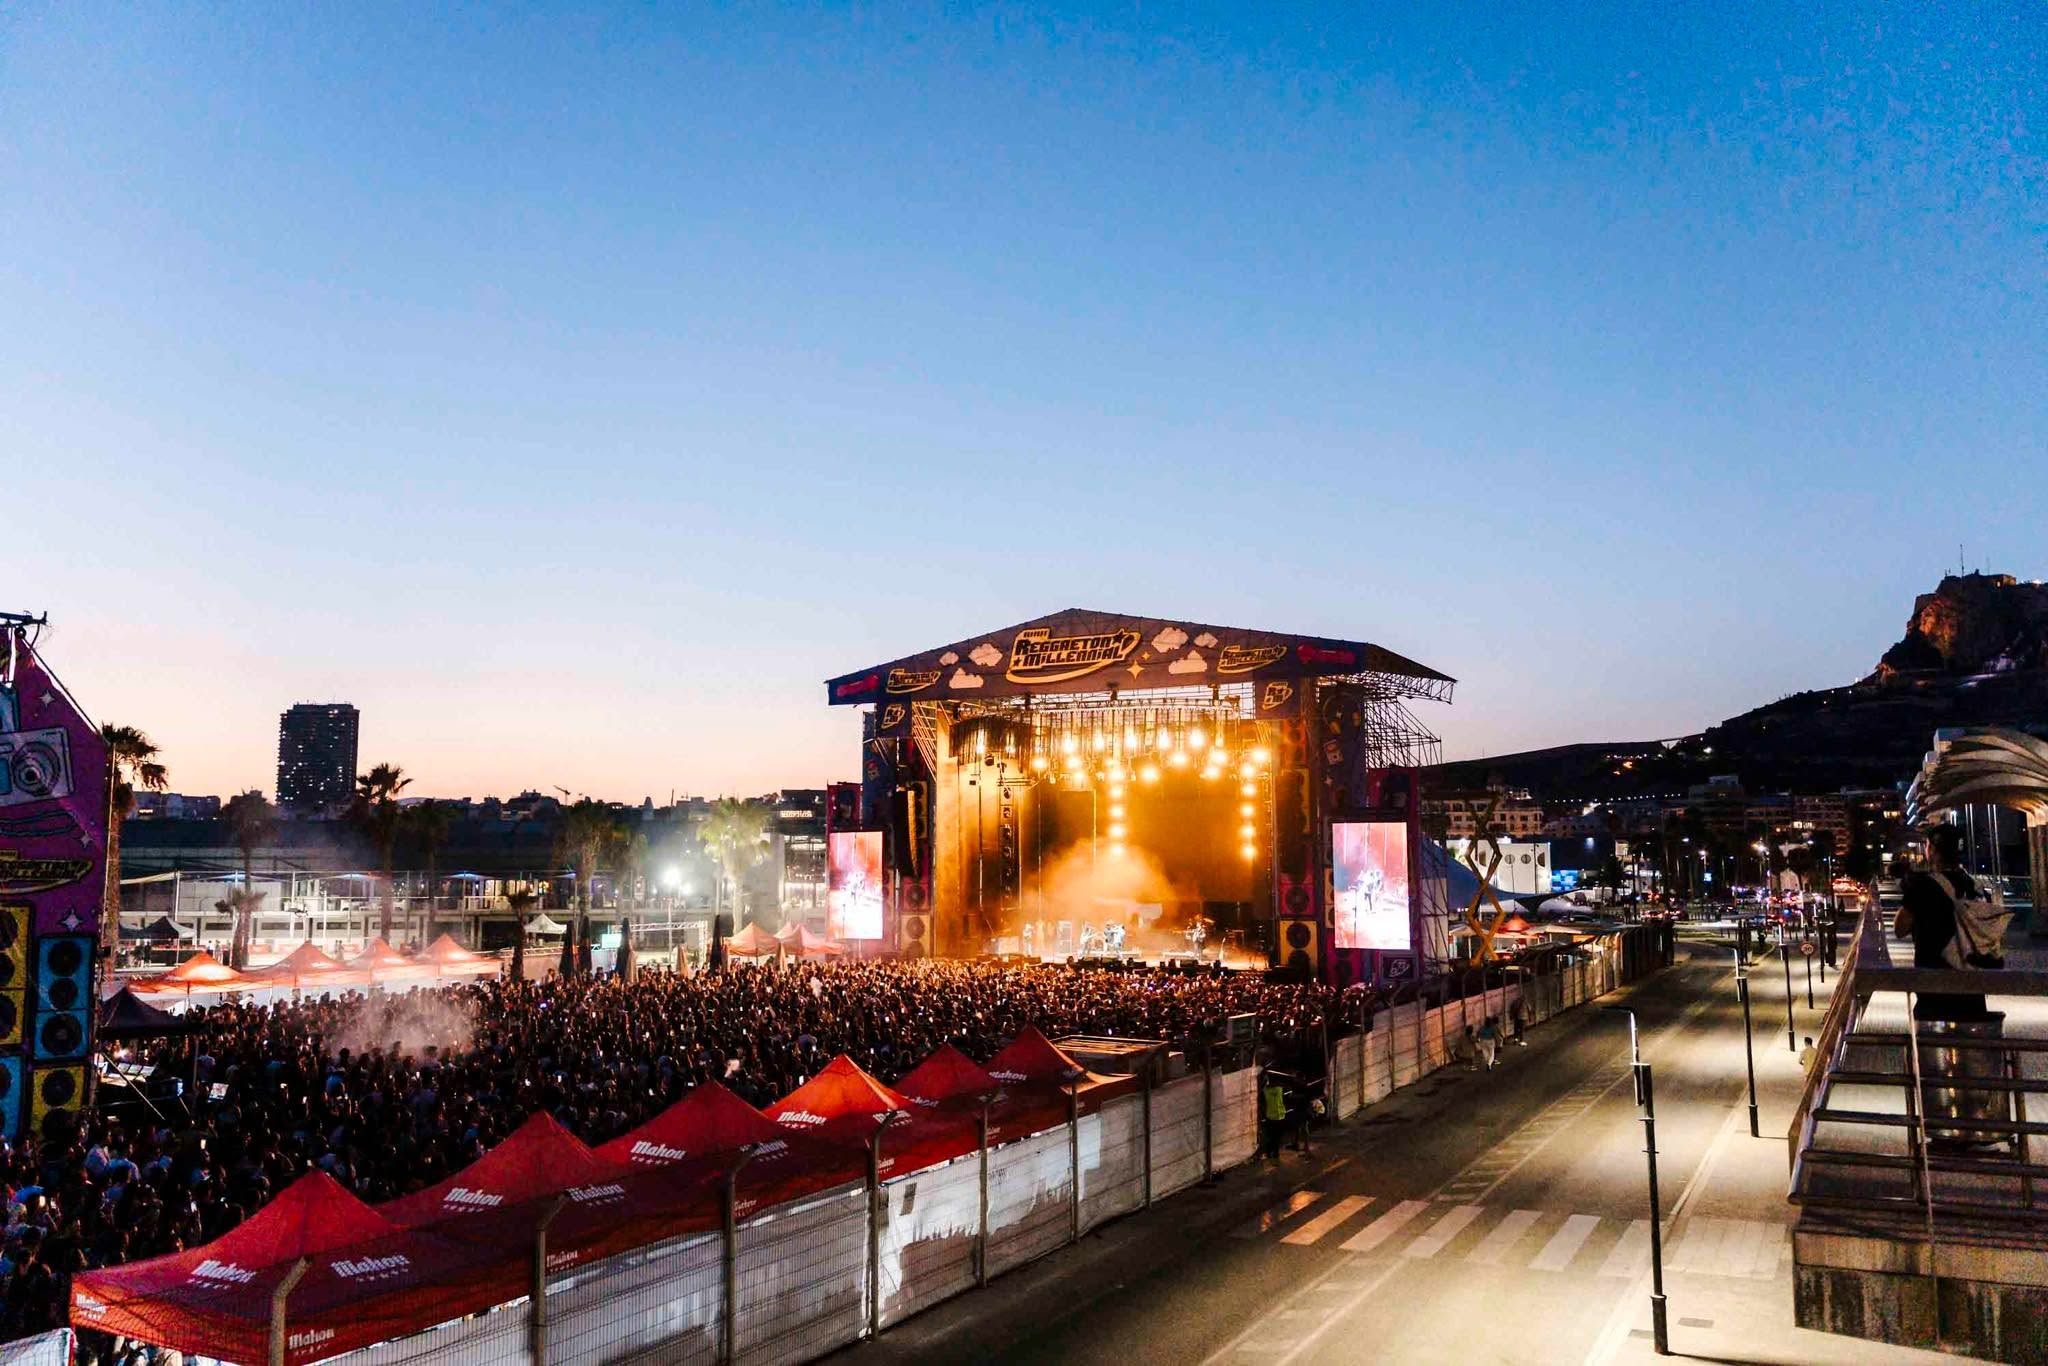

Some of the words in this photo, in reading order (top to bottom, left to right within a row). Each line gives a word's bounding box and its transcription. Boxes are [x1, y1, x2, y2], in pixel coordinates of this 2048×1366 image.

[776, 1110, 828, 1125] Mahou
[631, 1140, 688, 1160] Mahou
[443, 1187, 504, 1207] Mahou
[192, 1259, 257, 1284] Mahou
[330, 1254, 410, 1278] Mahou
[288, 1328, 335, 1350] Mahou
